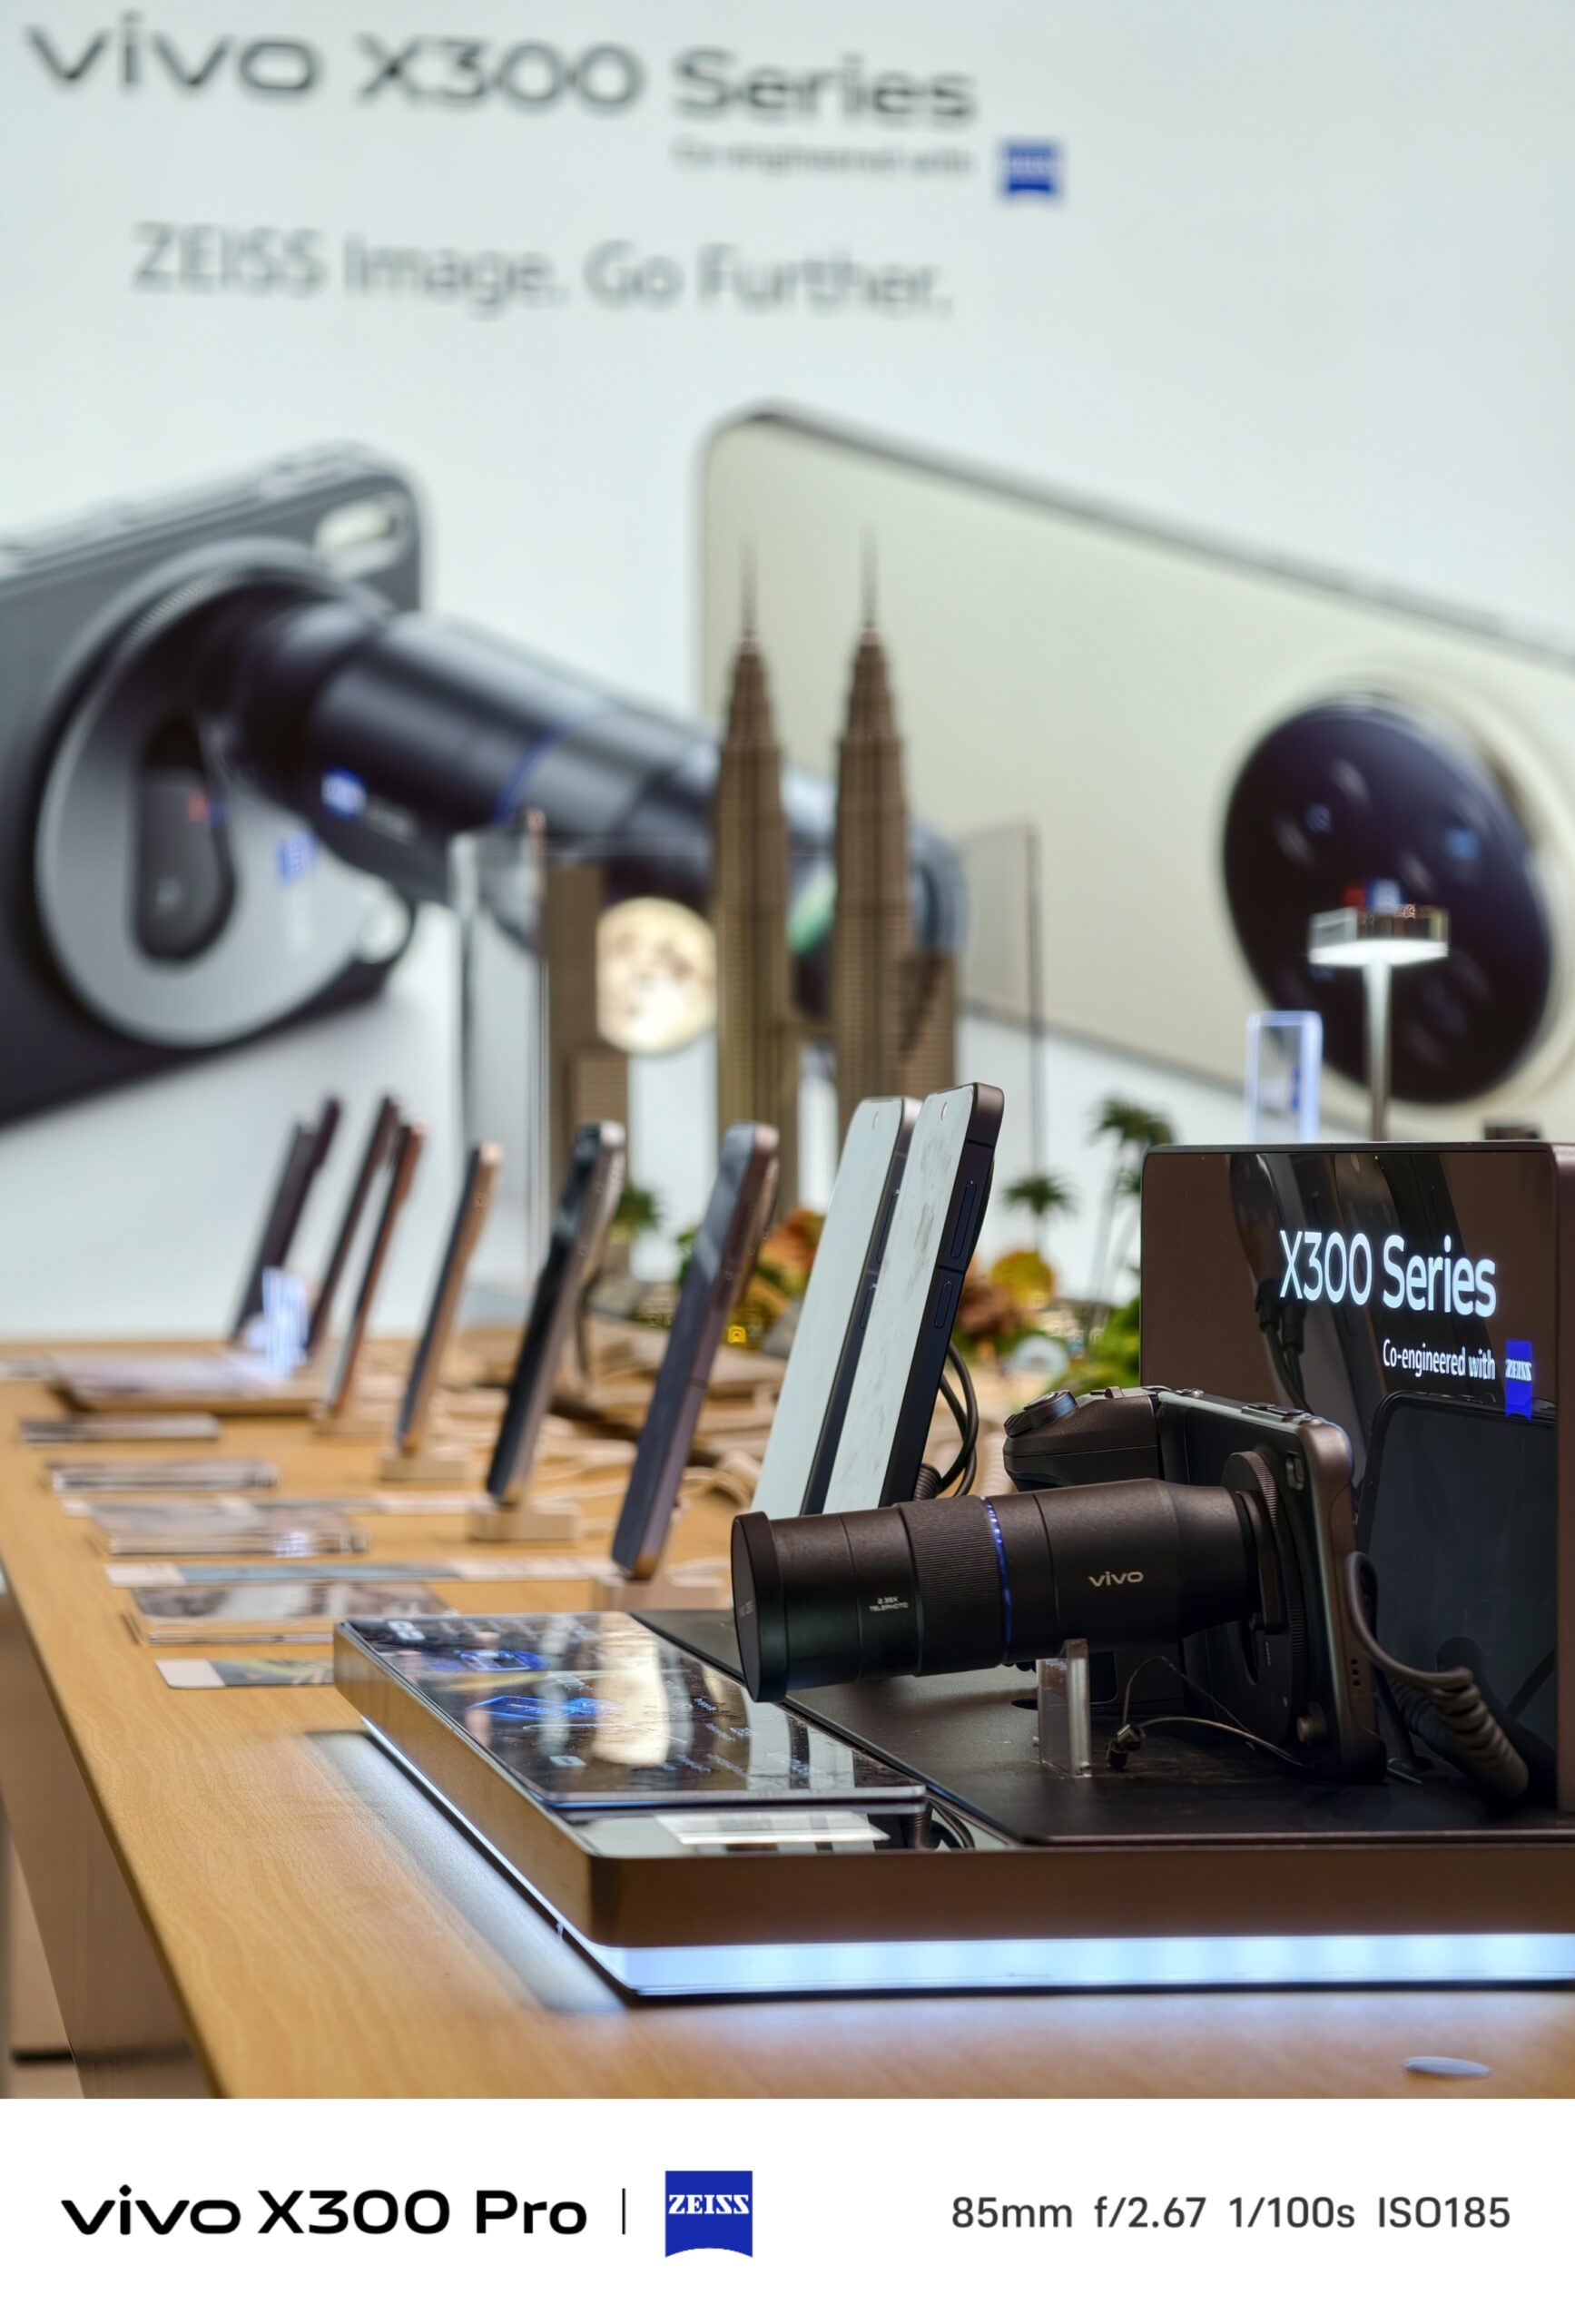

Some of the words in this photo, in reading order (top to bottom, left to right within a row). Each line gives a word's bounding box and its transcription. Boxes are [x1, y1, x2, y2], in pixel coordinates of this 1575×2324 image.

[25, 10, 325, 102] vivo
[358, 33, 645, 113] X300
[673, 47, 976, 124] Series
[133, 222, 327, 296] ZEISS
[342, 236, 566, 320] Image.
[583, 240, 684, 309] Go
[696, 242, 951, 317] Further.
[1279, 1229, 1373, 1305] X300
[1383, 1234, 1497, 1317] Series
[1383, 1338, 1466, 1377] Co-engineered
[1468, 1348, 1496, 1380] with
[1505, 1358, 1532, 1382] ZEISS
[1088, 1571, 1144, 1587] vivo
